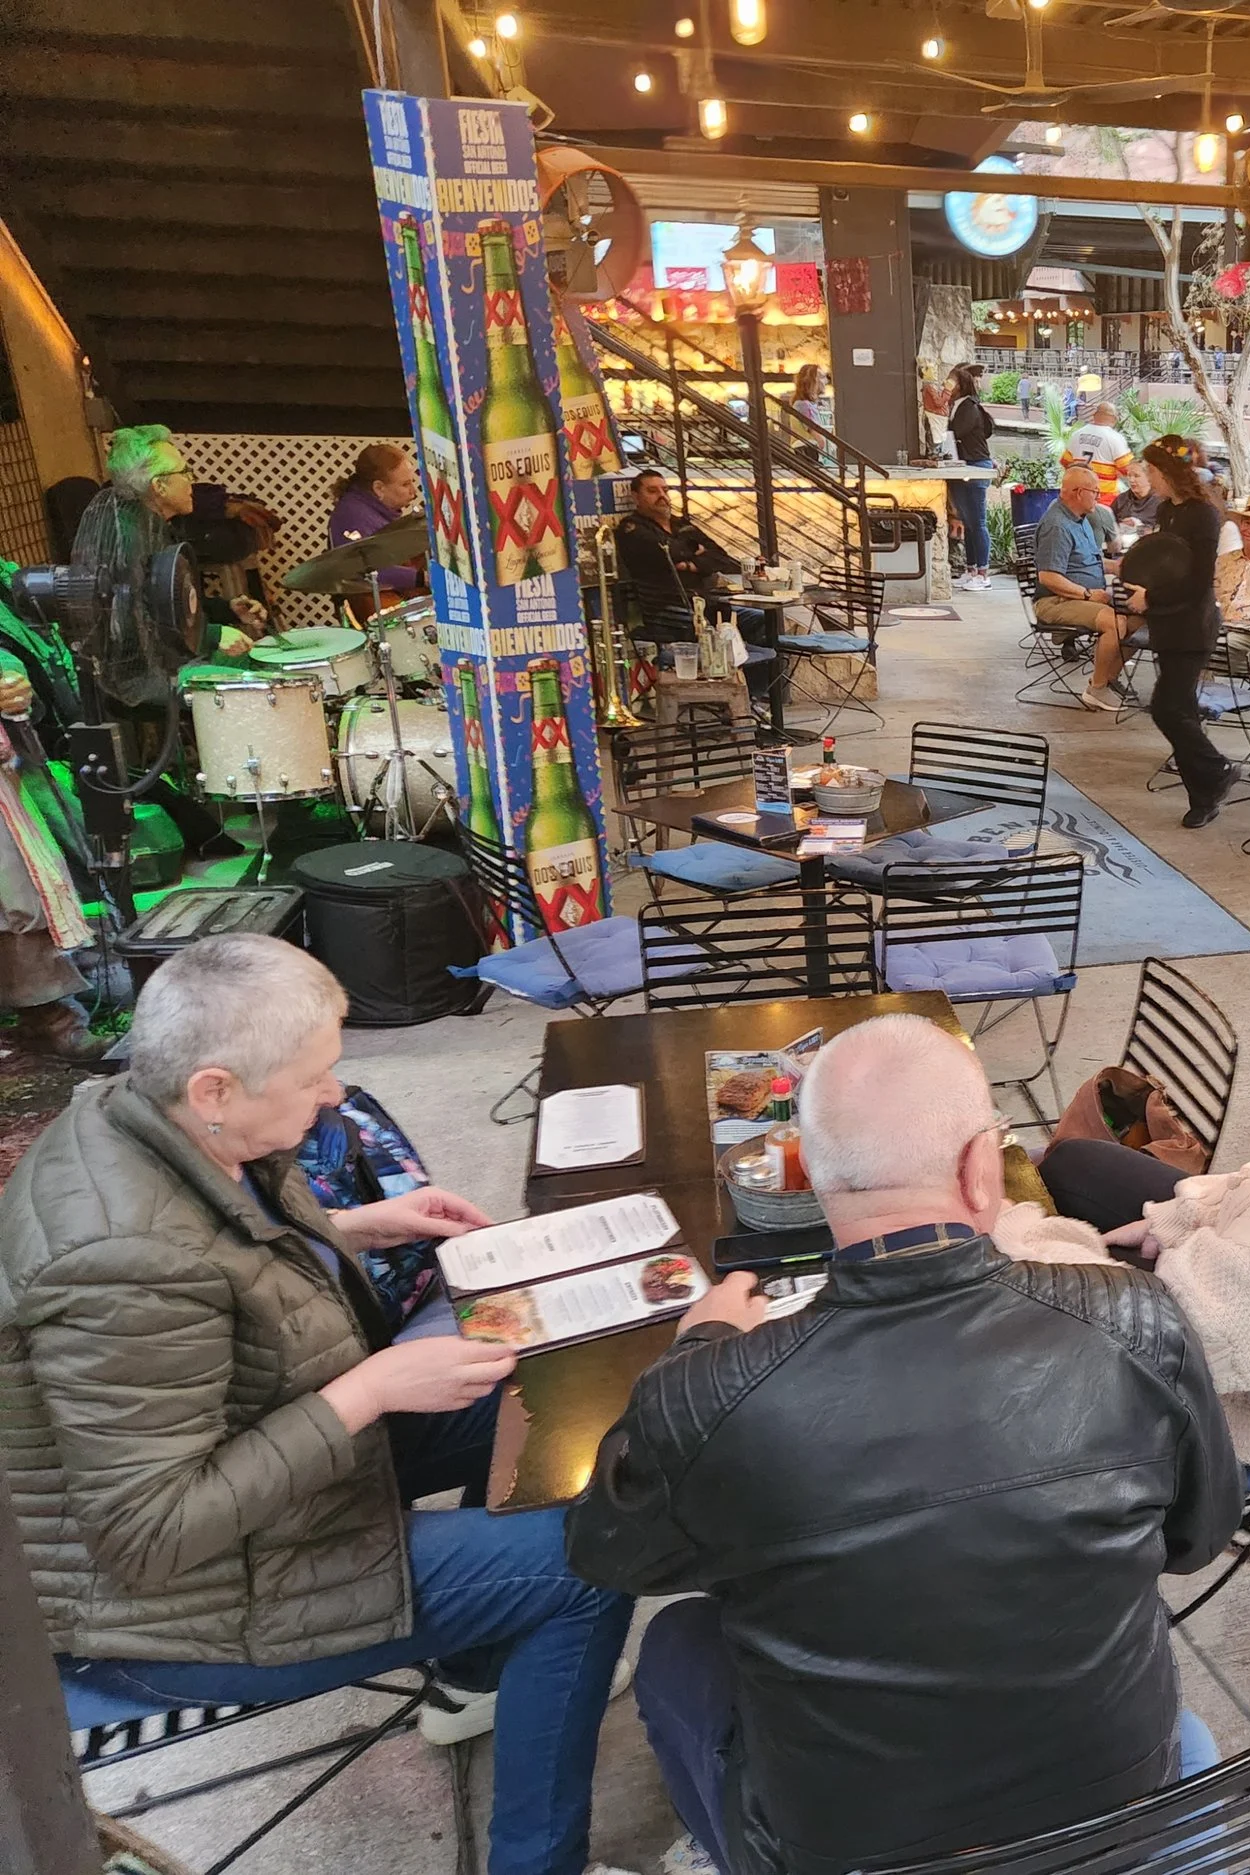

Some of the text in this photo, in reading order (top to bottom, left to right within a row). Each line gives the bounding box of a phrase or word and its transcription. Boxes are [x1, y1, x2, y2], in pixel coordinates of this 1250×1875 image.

[458, 109, 505, 144] FIESTA
[436, 178, 539, 213] BIENVENIDOS
[485, 291, 525, 330] XX
[564, 403, 601, 422] OS EQUIS
[562, 420, 615, 462] XX
[1082, 450, 1094, 464] 7
[490, 461, 513, 482] DOS
[516, 453, 551, 477] EQUIS
[427, 471, 469, 551] XX
[489, 478, 565, 552] XX
[490, 622, 584, 658] BIENVENIDOS
[532, 717, 569, 752] XX
[534, 864, 558, 885] DOS
